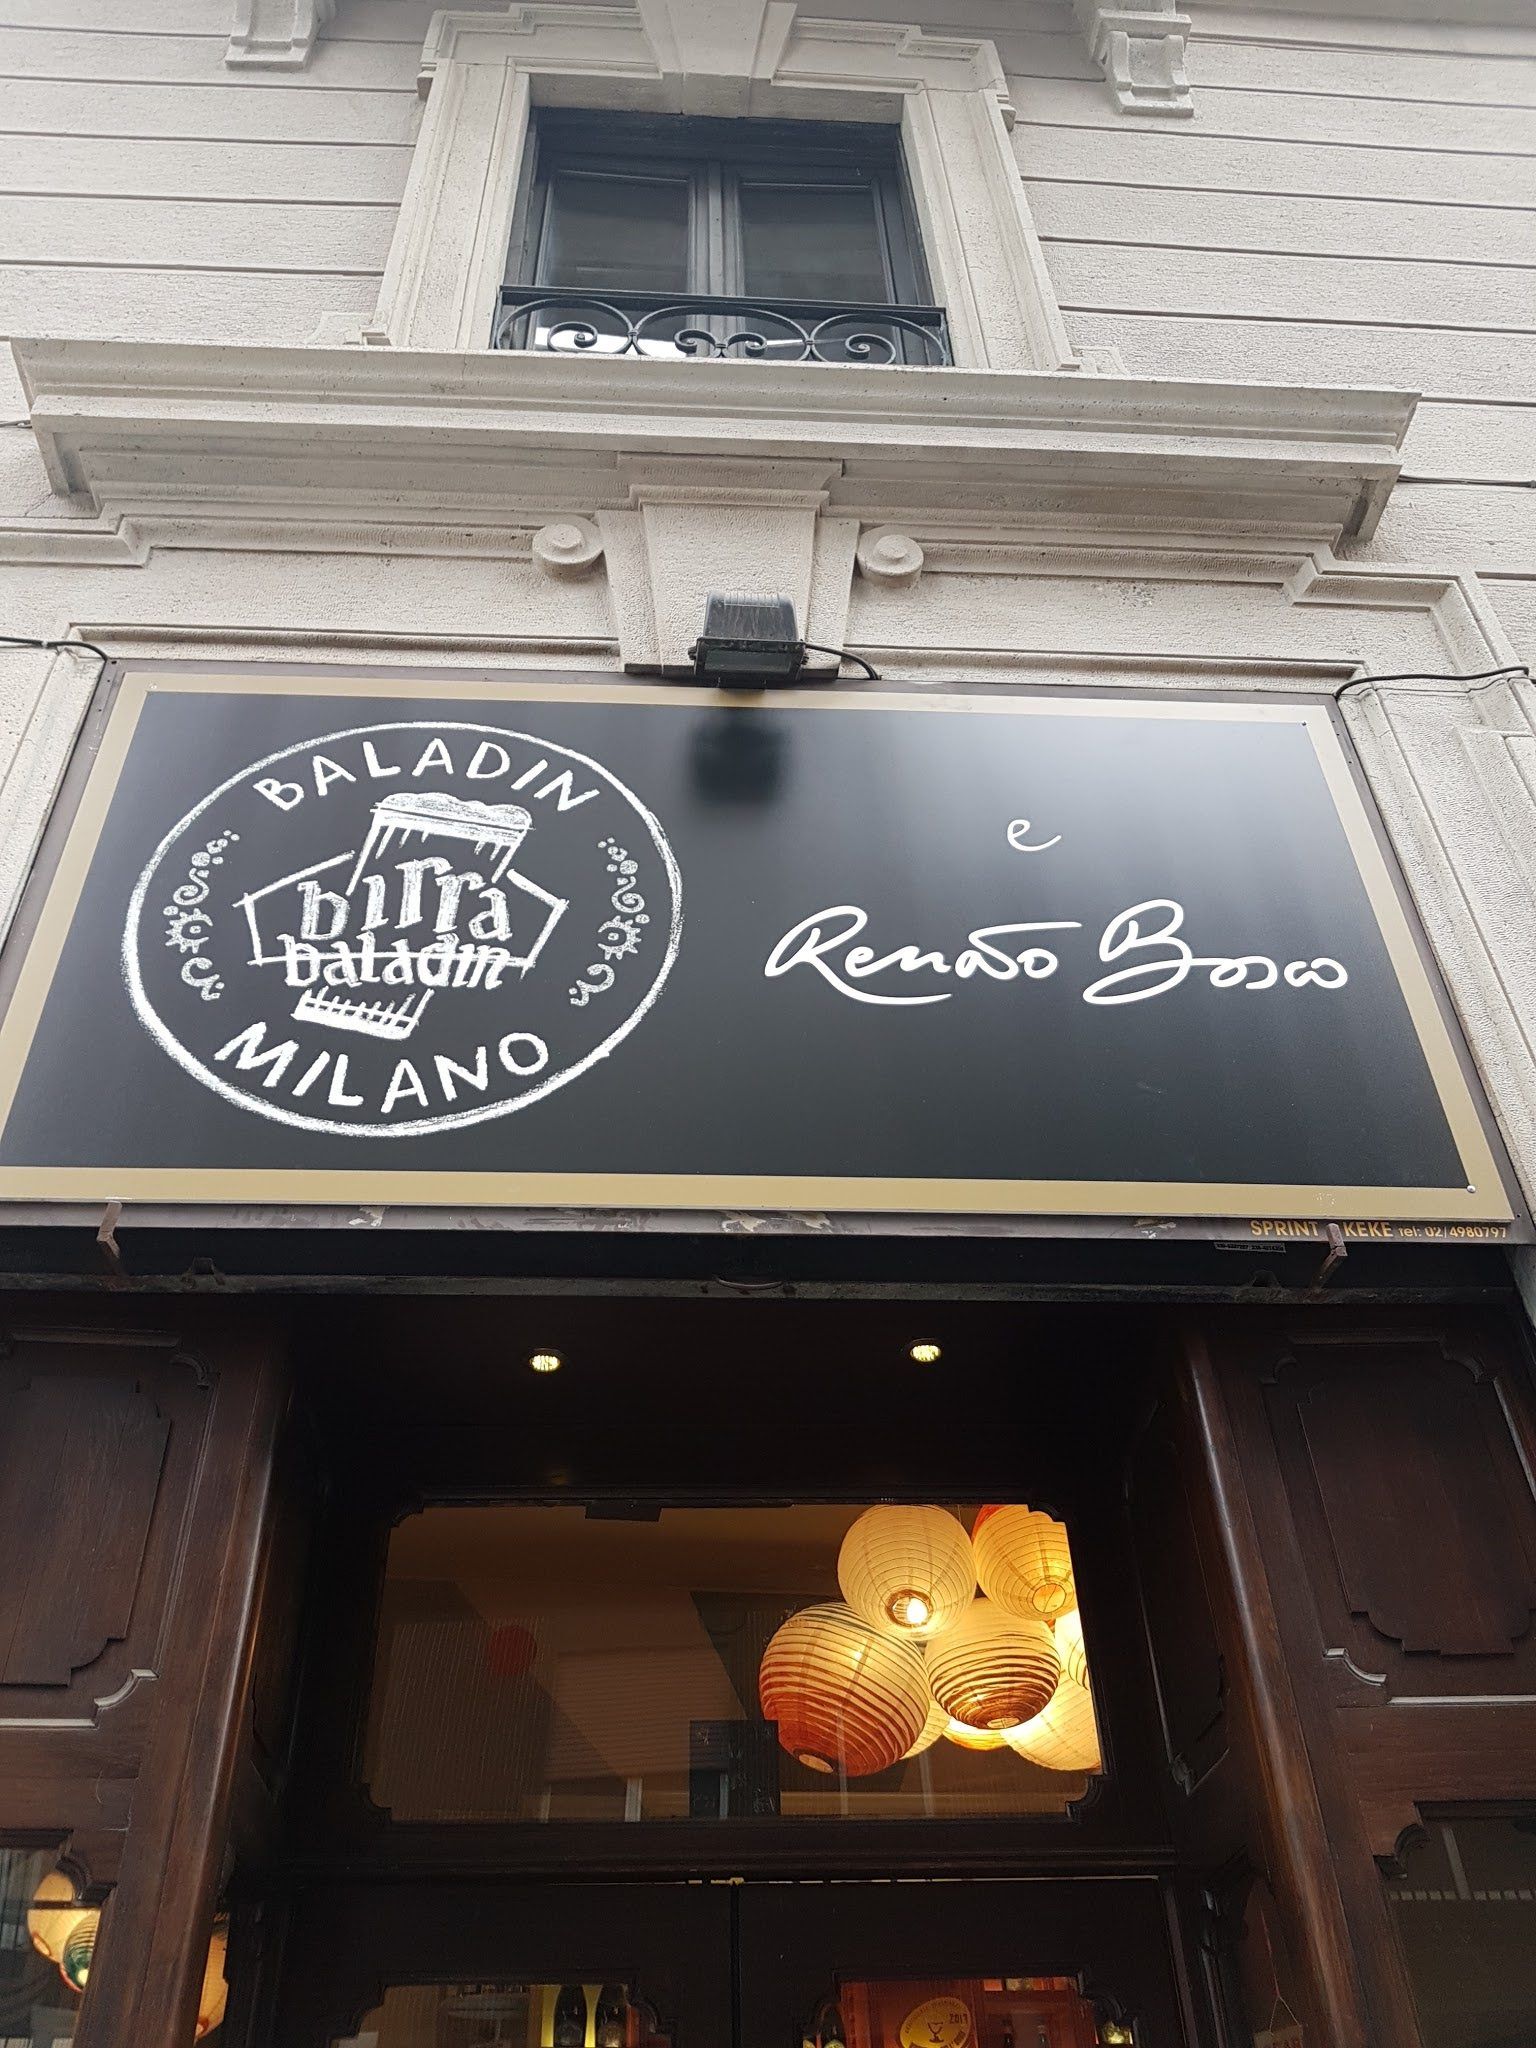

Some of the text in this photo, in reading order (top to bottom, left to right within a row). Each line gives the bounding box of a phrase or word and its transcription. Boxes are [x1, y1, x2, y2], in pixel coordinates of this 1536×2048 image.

[254, 738, 600, 812] BALADIN
[1006, 818, 1062, 852] e
[298, 857, 513, 942] birra
[276, 932, 516, 990] baladin
[764, 899, 1349, 1005] Renato Bosco
[214, 1021, 549, 1113] MILANO
[1250, 1220, 1319, 1237] SPRINT
[1344, 1221, 1394, 1238] KEKE
